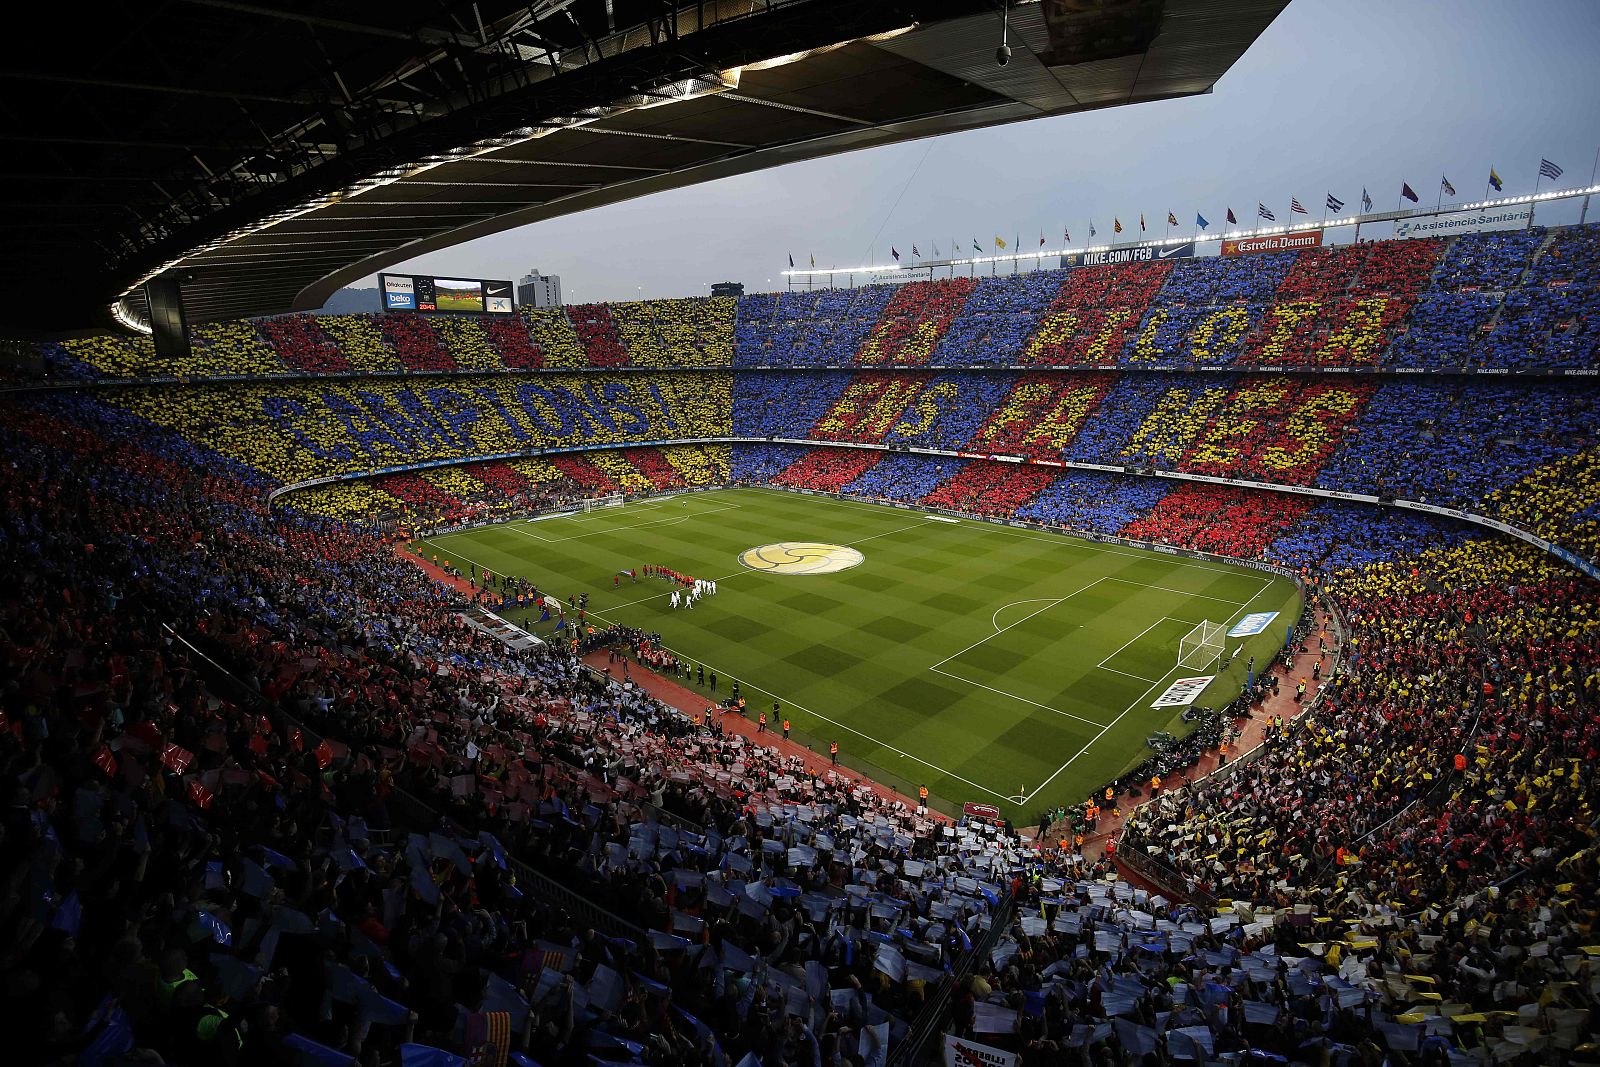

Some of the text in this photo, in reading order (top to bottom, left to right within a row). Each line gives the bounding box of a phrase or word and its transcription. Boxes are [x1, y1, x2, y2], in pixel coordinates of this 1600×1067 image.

[1413, 210, 1530, 232] Assistència Sanitària
[1238, 236, 1315, 252] Estrella Damm
[1084, 248, 1152, 265] NIKE.COM/FCB
[390, 294, 410, 303] beko
[439, 524, 466, 534] Rakuten
[1062, 529, 1086, 538] KONAMI
[1129, 541, 1145, 549] beko
[1154, 545, 1177, 554] Gillette
[1552, 546, 1563, 555] beko
[1223, 558, 1256, 569] KONAMI
[1566, 554, 1577, 563] beko
[1259, 562, 1292, 578] Rakuten
[1580, 561, 1590, 571] beko
